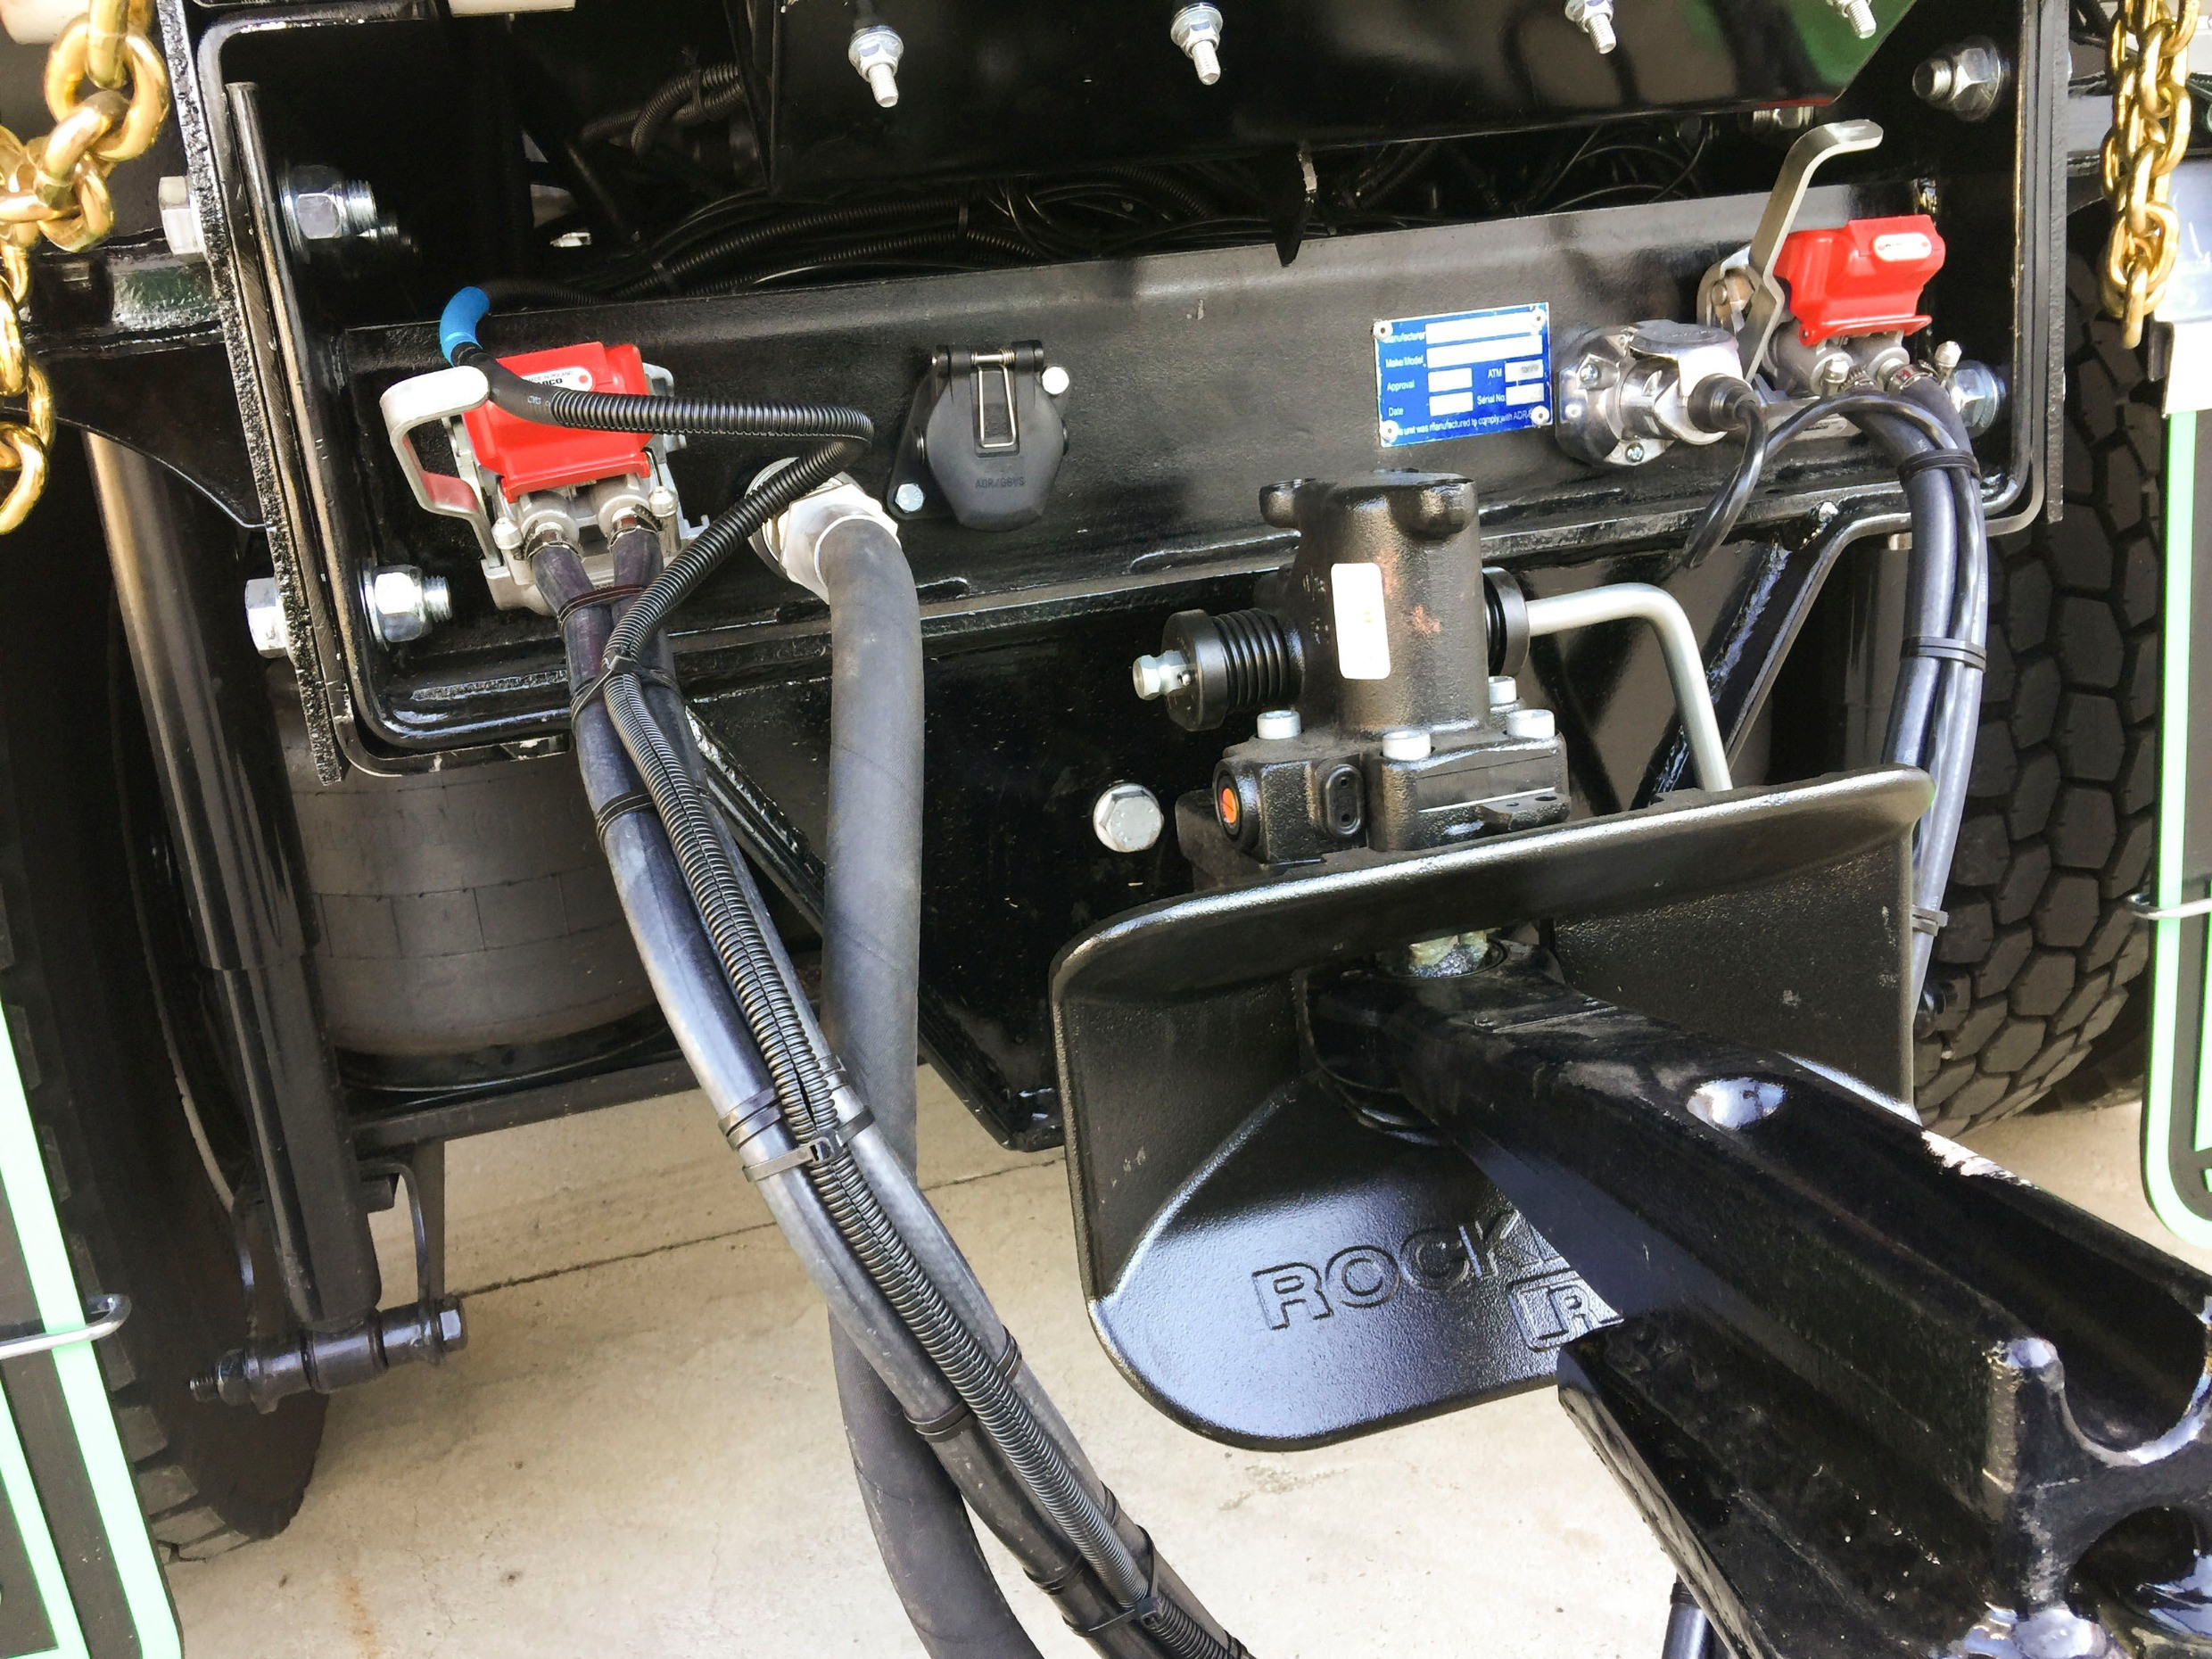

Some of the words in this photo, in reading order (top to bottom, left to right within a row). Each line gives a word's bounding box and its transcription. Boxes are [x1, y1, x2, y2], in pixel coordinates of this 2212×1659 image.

[1488, 367, 1503, 379] ATM
[1387, 379, 1416, 392] Approval
[1477, 394, 1496, 406] Serial
[1388, 407, 1404, 417] Date
[1251, 1209, 1562, 1331] ROCK
